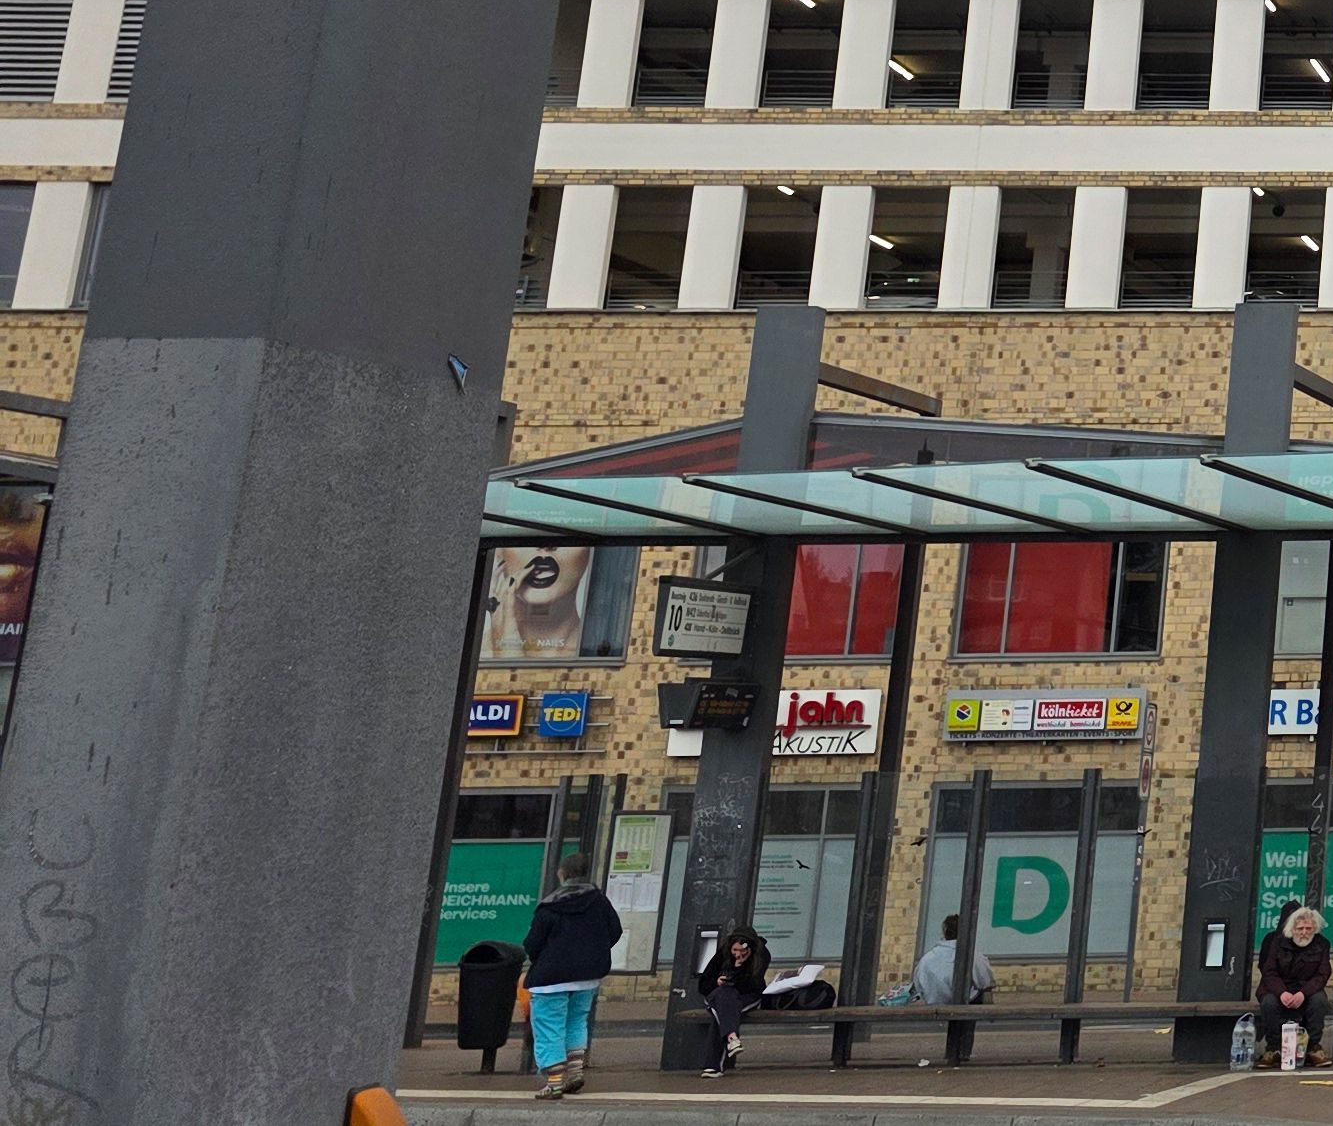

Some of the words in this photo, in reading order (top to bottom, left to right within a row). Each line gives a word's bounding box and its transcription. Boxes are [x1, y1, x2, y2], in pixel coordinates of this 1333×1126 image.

[668, 605, 683, 631] 10
[783, 692, 864, 738] jahn
[1040, 702, 1099, 718] kölnticket
[1265, 850, 1308, 868] Weil
[1263, 871, 1299, 888] wir
